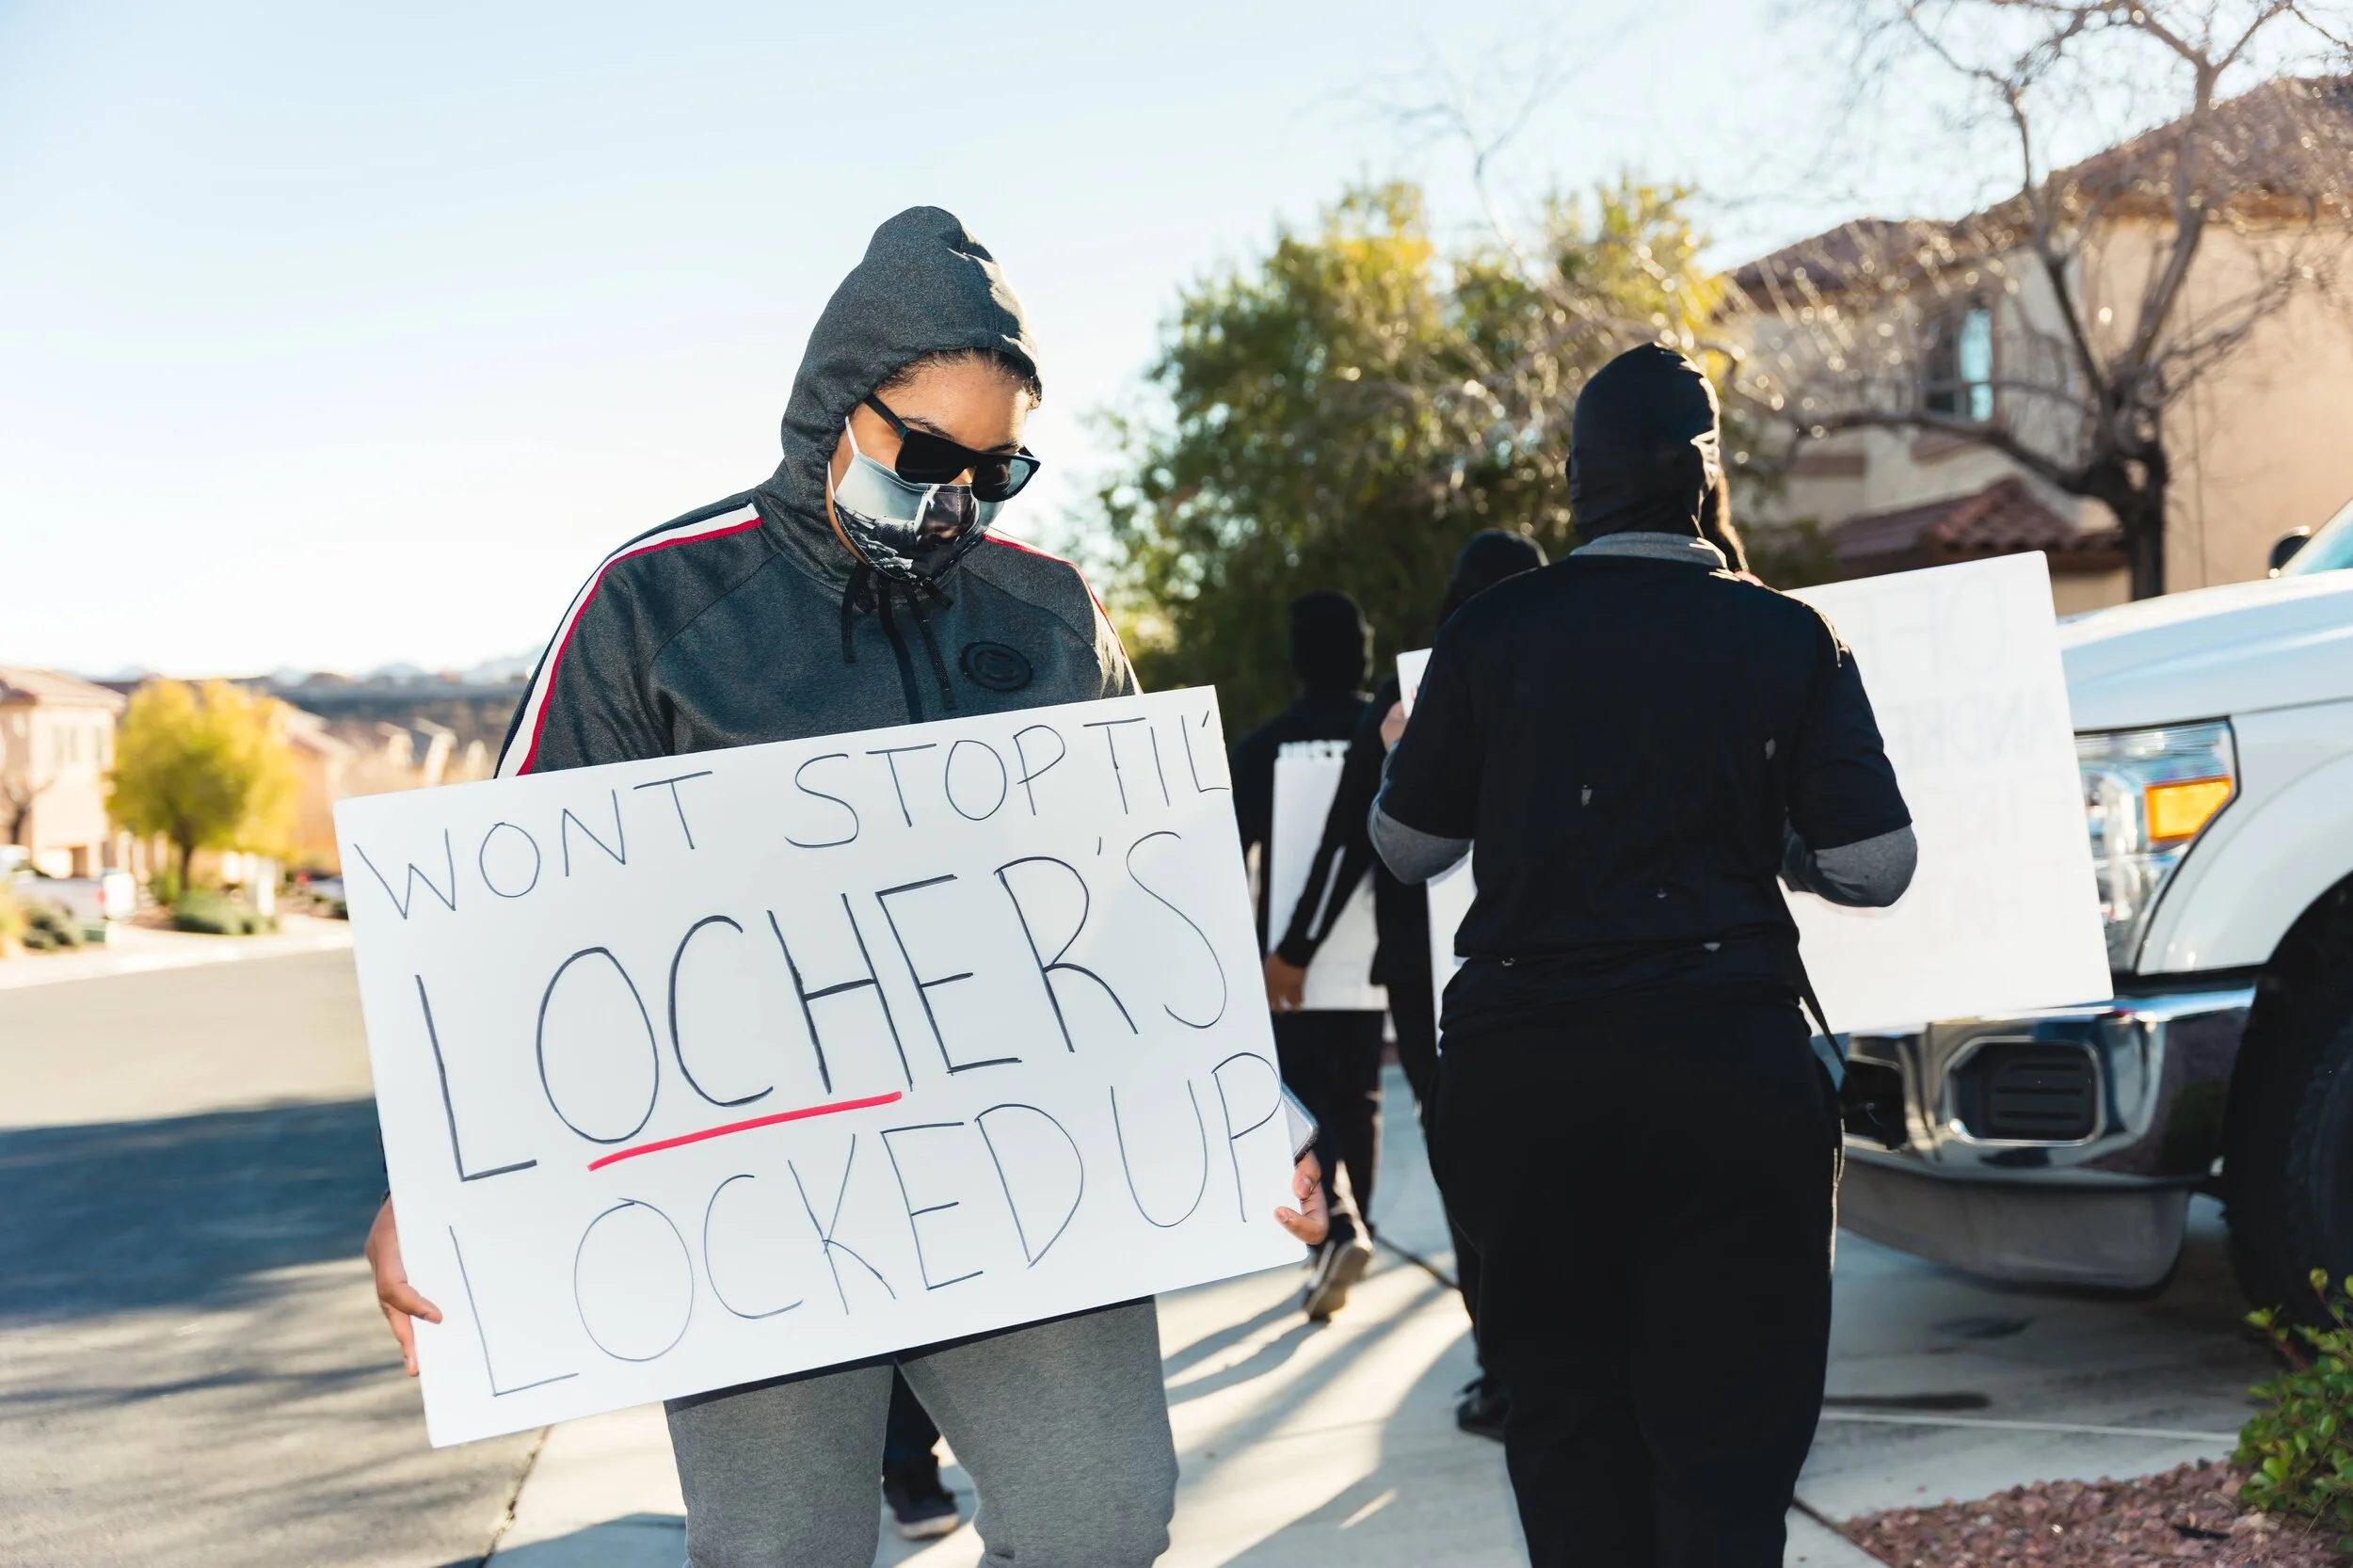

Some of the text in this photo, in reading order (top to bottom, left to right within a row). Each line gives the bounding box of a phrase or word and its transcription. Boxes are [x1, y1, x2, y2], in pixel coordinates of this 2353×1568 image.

[353, 770, 713, 920] WONT
[783, 724, 1066, 849] STOP
[414, 830, 1228, 1183] LOCHER'S
[448, 1051, 1283, 1399] LOCKED UP
